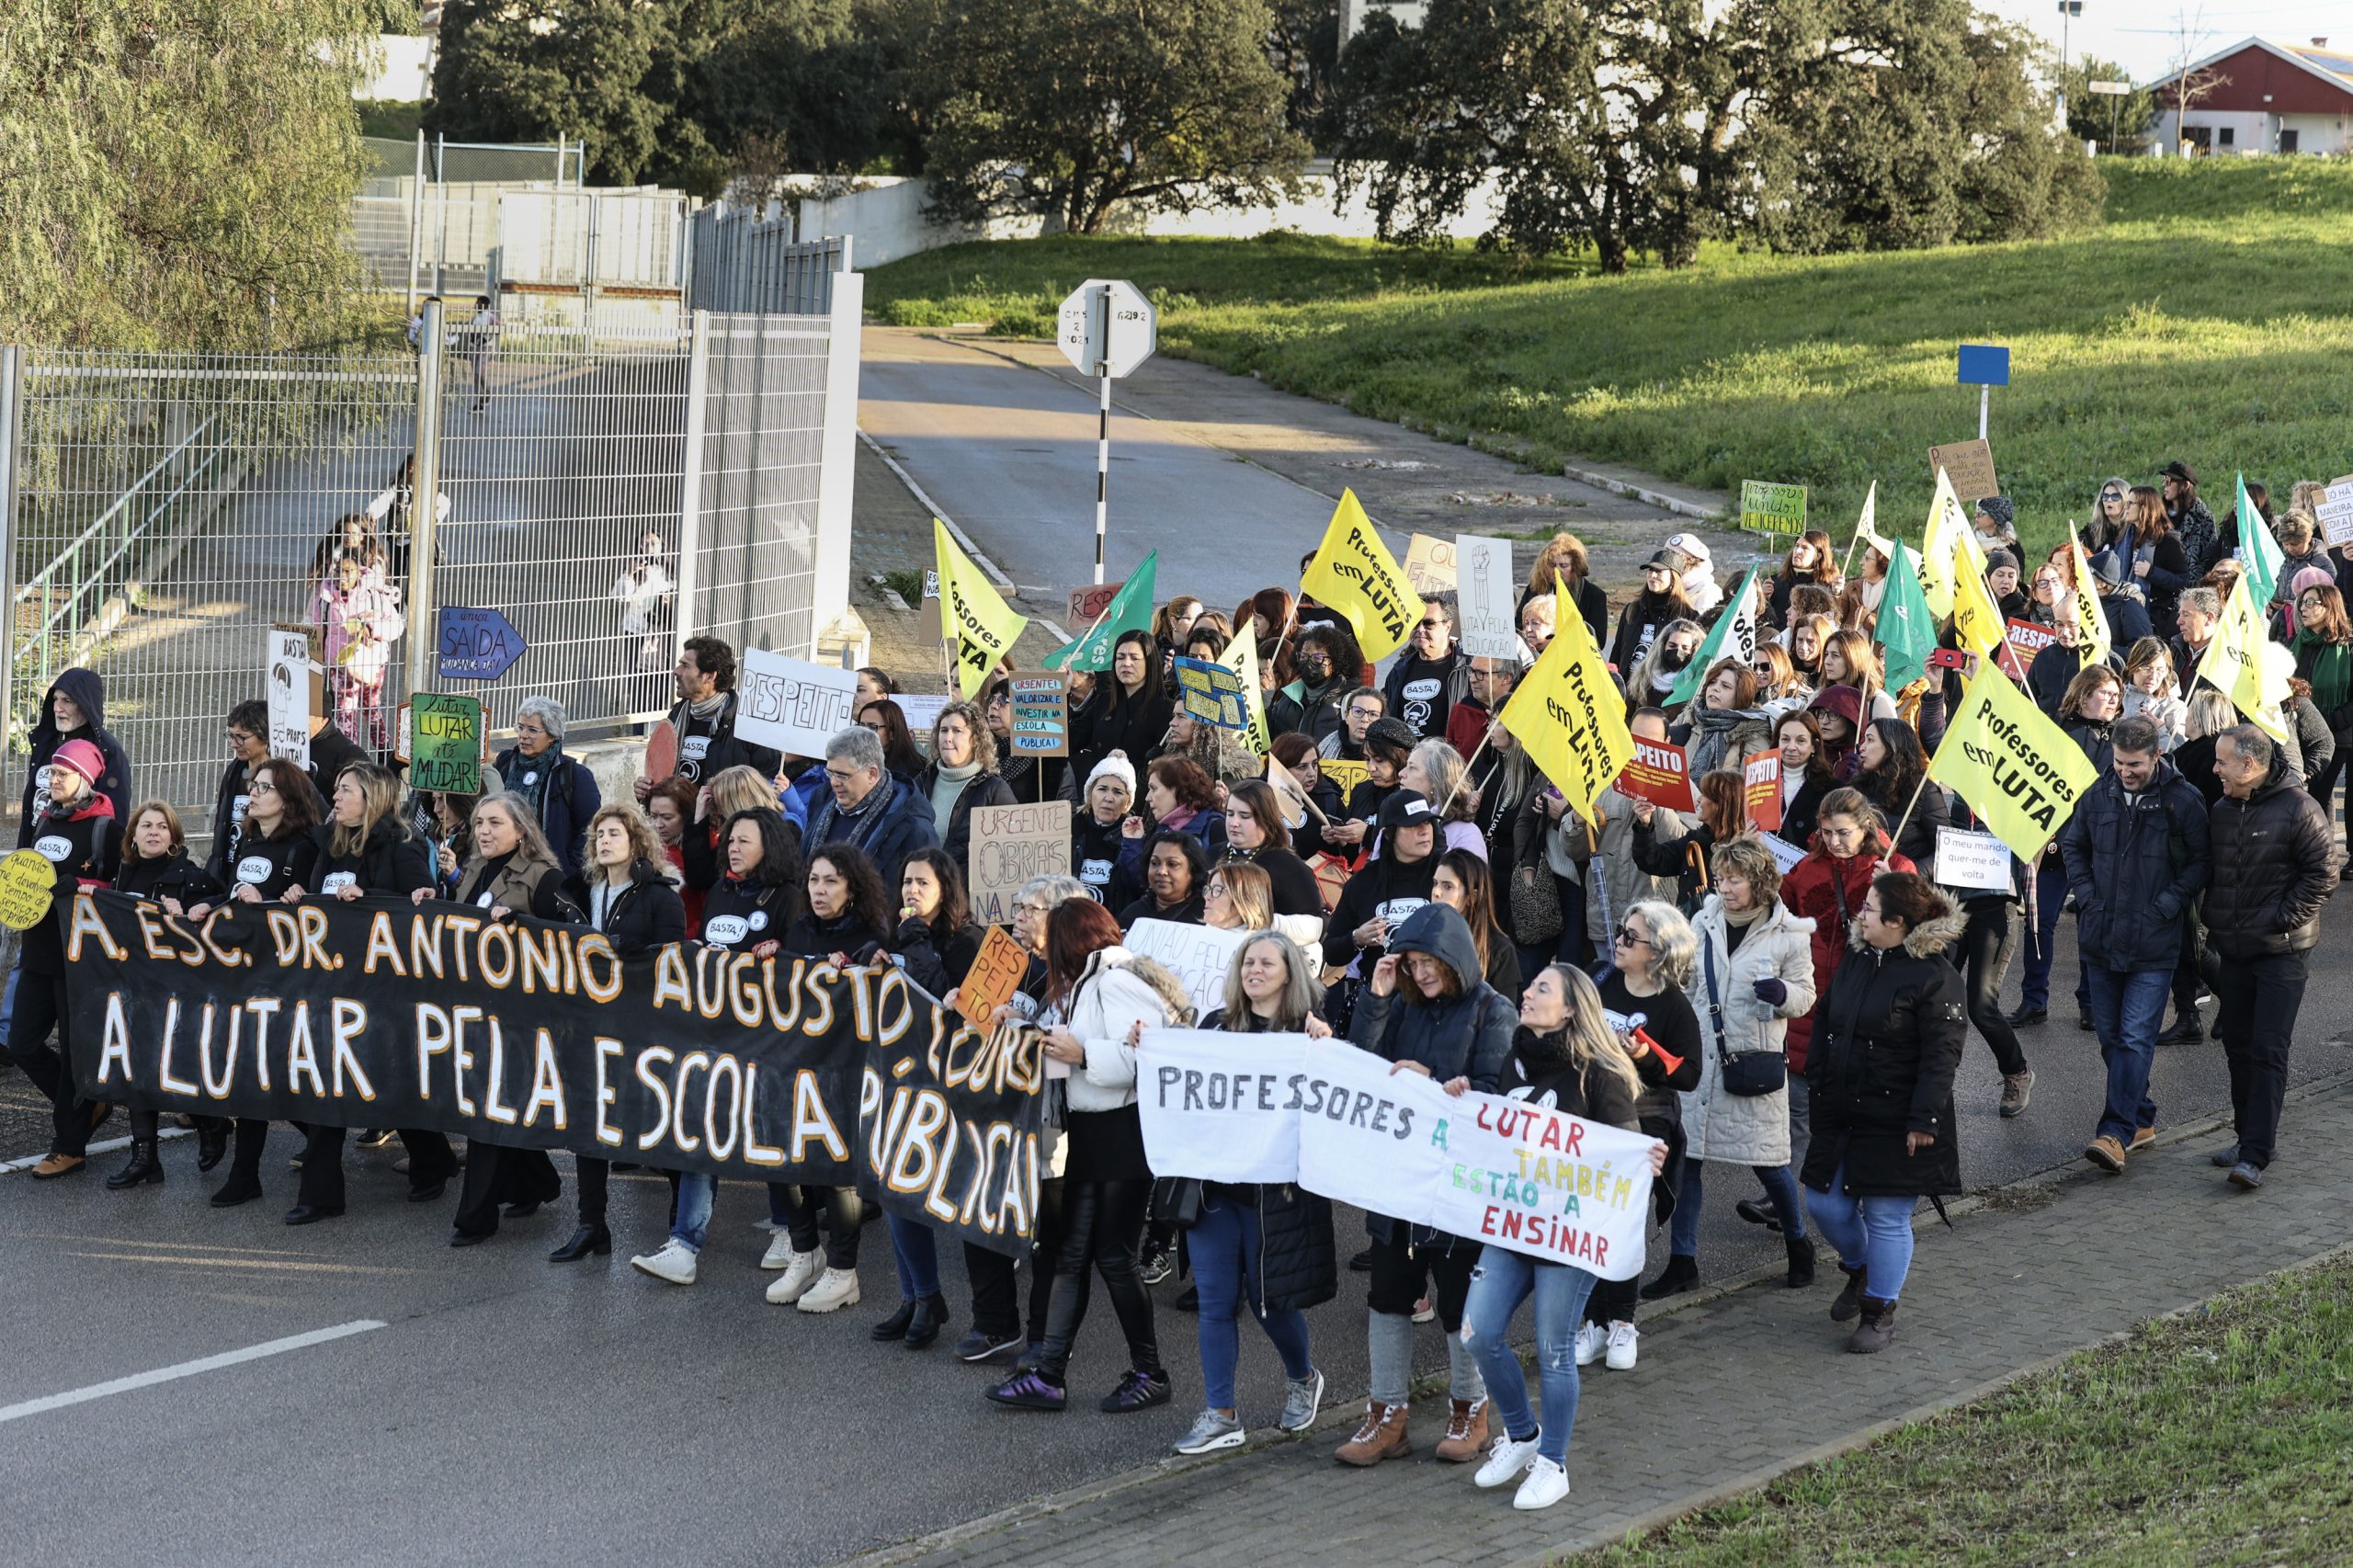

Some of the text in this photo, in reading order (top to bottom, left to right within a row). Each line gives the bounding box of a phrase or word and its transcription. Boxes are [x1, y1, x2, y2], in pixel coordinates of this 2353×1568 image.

[1347, 527, 1413, 625] Professores
[1333, 562, 1404, 643] em LUTA
[441, 623, 508, 659] SAÍDA
[1488, 617, 1509, 635] PELA
[959, 632, 989, 672] TA
[1466, 635, 1512, 656] EDUCAÇÃO
[737, 668, 857, 733] RESPEITO
[1015, 695, 1062, 705] VALORIZAR E
[1406, 683, 1438, 695] BASTA!
[1015, 708, 1062, 719] INVESTIR NA
[1016, 722, 1047, 732] ESCOLA
[1546, 697, 1574, 733] em
[1563, 661, 1613, 779] Professores
[286, 728, 306, 746] PROFS
[432, 741, 457, 759] até
[1020, 737, 1057, 748] PÚBLICA!
[1976, 698, 2075, 803] Professores
[414, 753, 478, 791] MUDAR!
[1631, 743, 1683, 773] PEITO
[1962, 740, 2057, 832] em LUTA
[980, 804, 1070, 837] URGENTE
[37, 842, 68, 857] BASTA!
[1943, 836, 2008, 854] O meu marido
[1948, 853, 2002, 868] quer-me de
[11, 854, 48, 873] quando
[240, 863, 268, 878] BASTA!
[979, 839, 1068, 889] OBRAS
[1961, 869, 1985, 881] volta
[5, 883, 47, 908] tempo de
[710, 923, 745, 937] BASTA!
[985, 930, 1026, 976] RES
[68, 894, 129, 961] A.
[135, 902, 253, 967] ESC.
[267, 905, 344, 971] DR.
[364, 911, 624, 1004] ANTÓNIO
[653, 941, 914, 1047] AUGUSTO
[97, 992, 133, 1085] A
[160, 996, 378, 1102] LUTAR
[415, 1001, 567, 1131] PELA
[595, 1036, 850, 1166] ESCOLA
[1158, 1066, 1585, 1158] PROFESSORES A LUTAR
[1451, 1163, 1581, 1219] ESTÃO A
[1514, 1149, 1632, 1211] TAMBÉM
